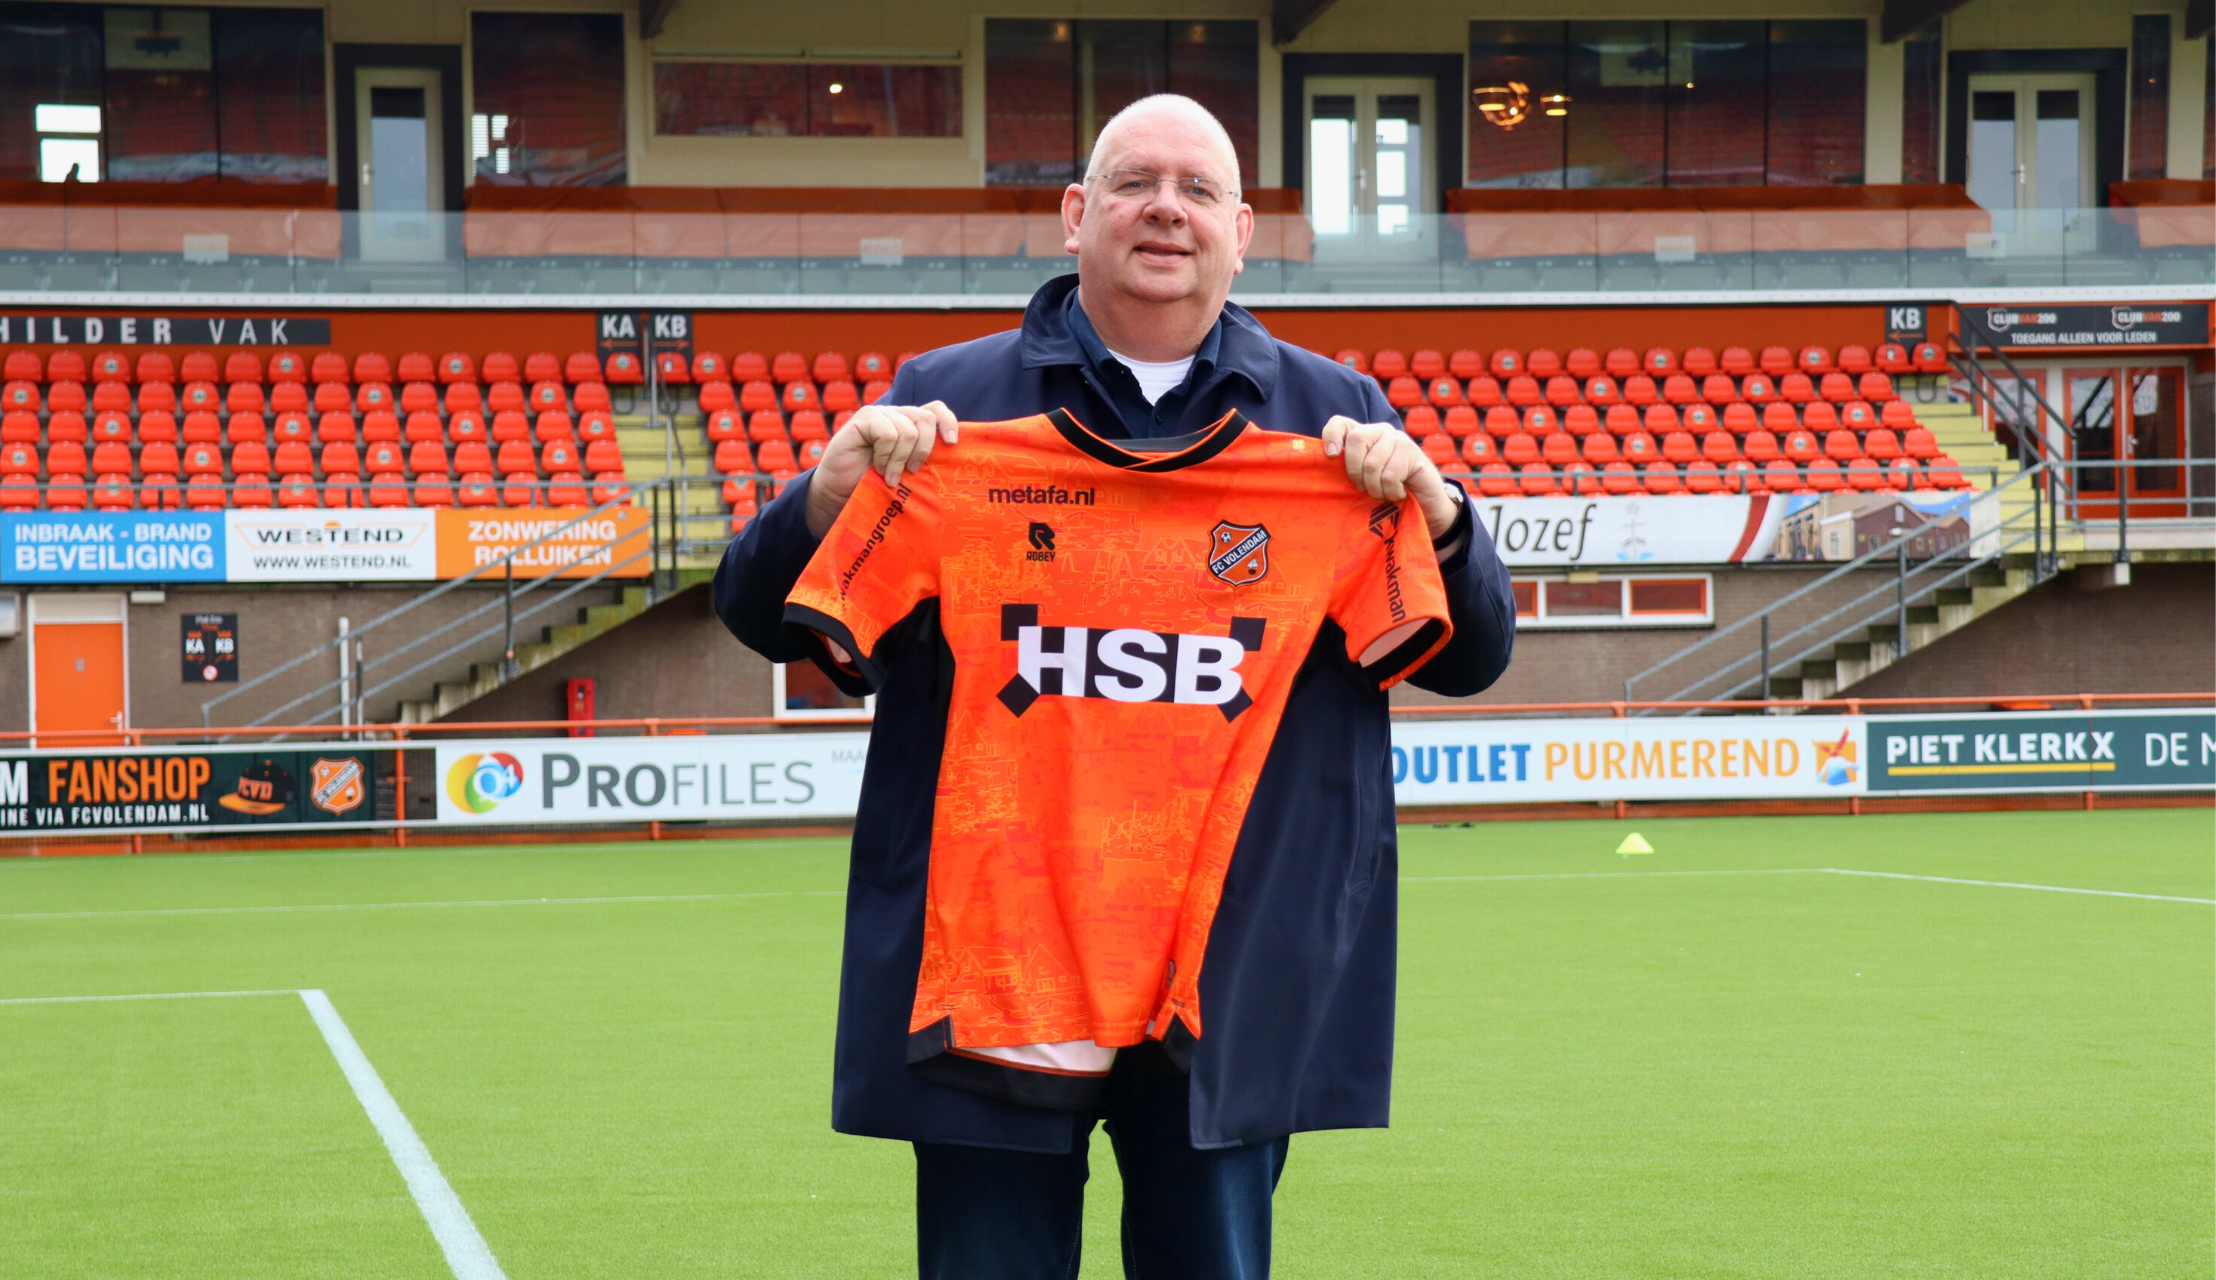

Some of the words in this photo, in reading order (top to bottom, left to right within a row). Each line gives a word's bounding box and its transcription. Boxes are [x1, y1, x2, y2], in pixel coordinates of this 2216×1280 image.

[602, 313, 636, 338] KA
[654, 313, 687, 338] KB
[1890, 307, 1921, 330] KB
[208, 318, 289, 345] VAK
[2011, 331, 2055, 345] TOEGANG
[2057, 331, 2094, 344] ALLEEN
[2096, 331, 2123, 343] VOOR
[2125, 331, 2157, 343] LEDEN
[988, 485, 1095, 506] metafa.nl
[15, 523, 115, 543] INBRAAK
[134, 523, 212, 542] BRAND
[257, 528, 404, 544] WESTEND
[468, 520, 617, 542] ZONWERING
[1489, 502, 1598, 561] Jozef
[15, 544, 214, 571] BEVEILIGING
[253, 554, 412, 571] WWW.WESTEND.NL
[474, 545, 613, 567] ROLLUIKEN
[1026, 551, 1056, 562] ROBEY
[1211, 561, 1225, 574] FC
[1223, 529, 1267, 566] VOLENDAM
[186, 638, 205, 654] KA
[215, 638, 234, 654] KB
[1018, 625, 1245, 705] HSB
[1887, 734, 1964, 764] PIET
[1974, 731, 2116, 762] KLERKX
[2145, 731, 2189, 767] DE
[1391, 744, 1531, 784] OUTLET
[1544, 738, 1800, 781] PURMEREND
[48, 757, 211, 804] FANSHOP
[35, 806, 65, 826] VIA
[71, 803, 210, 826] FCVOLENDAM.NL
